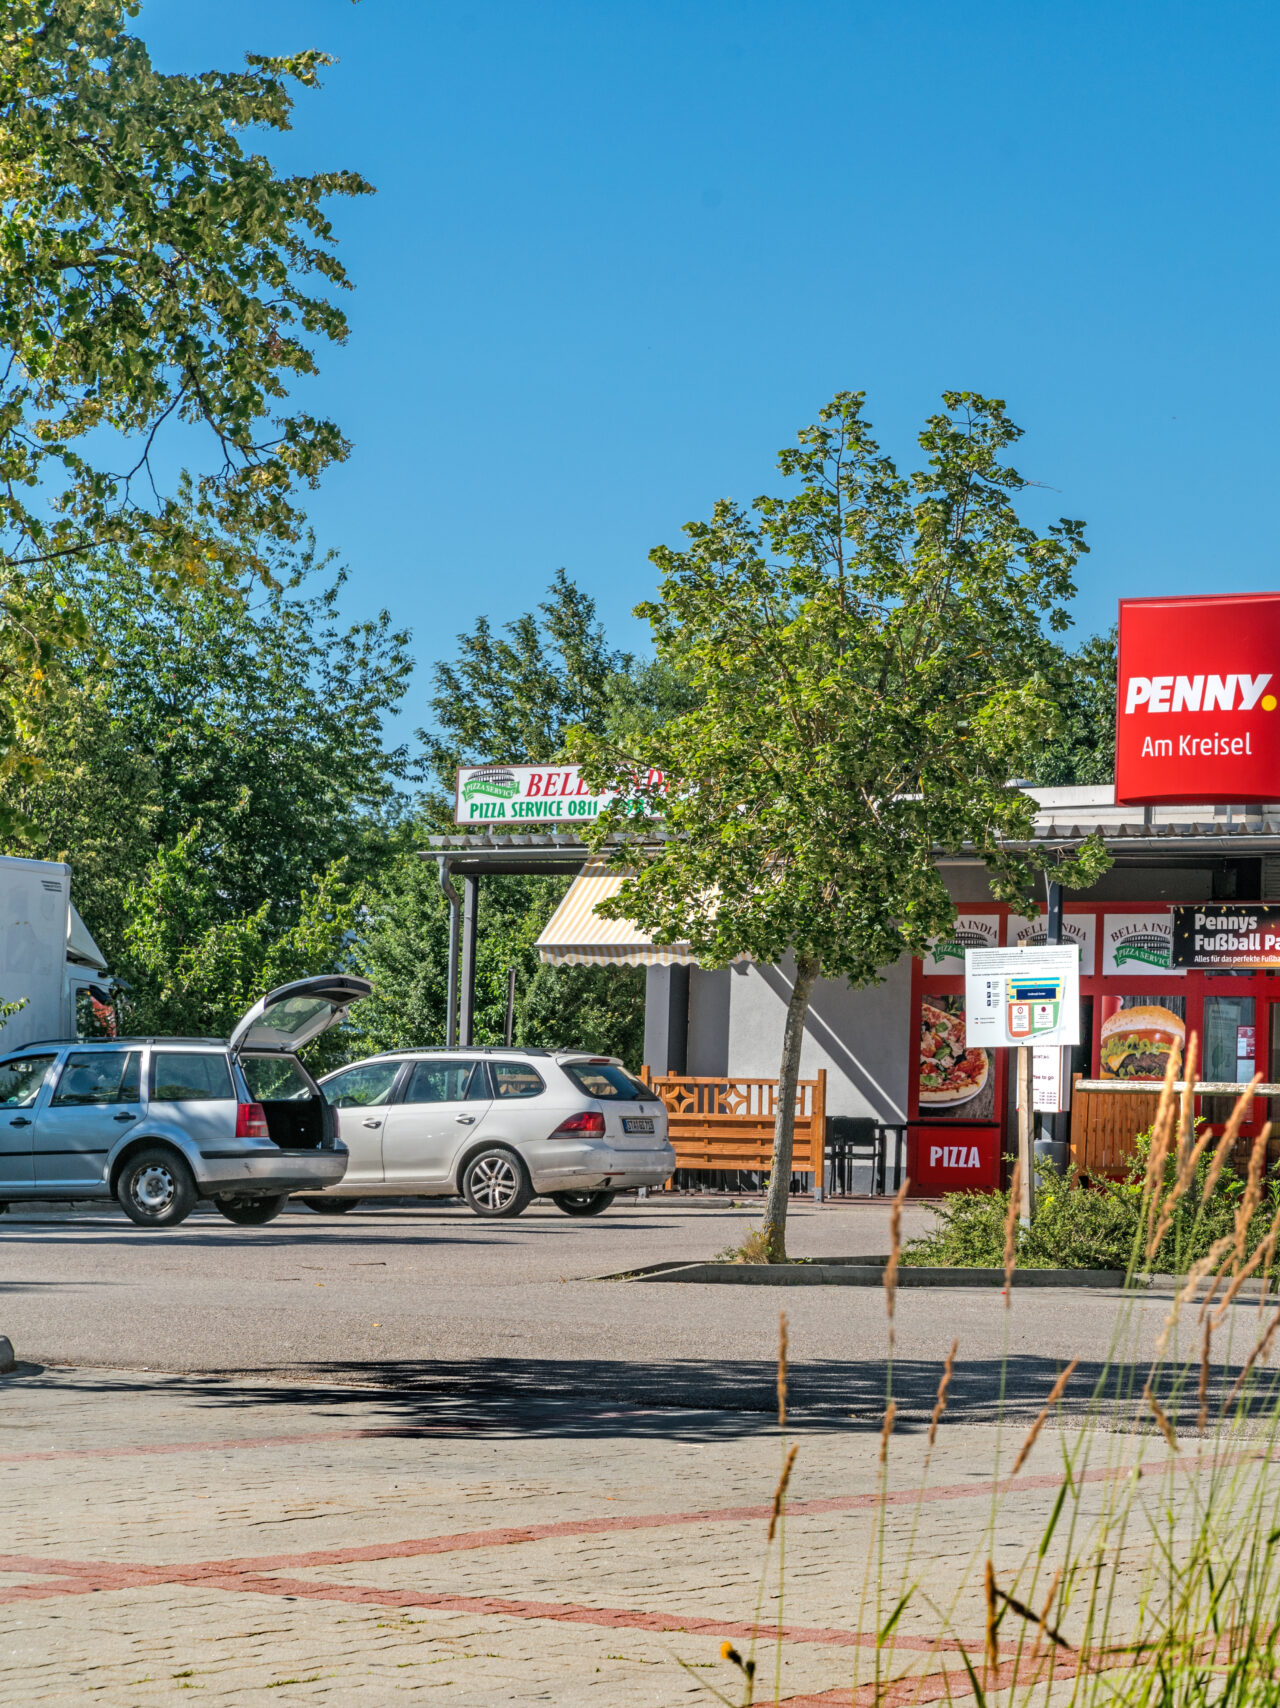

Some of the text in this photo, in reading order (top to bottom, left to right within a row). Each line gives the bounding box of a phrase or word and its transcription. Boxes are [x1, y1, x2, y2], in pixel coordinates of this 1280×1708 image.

[1125, 674, 1277, 714] PENNY.
[1141, 732, 1252, 757] Am Kreisel
[466, 782, 515, 797] PIZZA SERVICE
[469, 802, 506, 819] PIZZA
[510, 799, 563, 818] SERVICE
[567, 799, 598, 816] 0811
[968, 920, 998, 939] INDIA
[1017, 922, 1087, 941] BELL NDIA
[1110, 922, 1171, 942] BELLA IND
[1194, 913, 1258, 934] Pennys
[1194, 933, 1261, 951] Fußball
[1119, 947, 1139, 958] PIZZA
[1194, 955, 1210, 963] Alles
[1211, 954, 1220, 963] für
[1221, 954, 1233, 963] das
[1233, 955, 1261, 964] perfekte
[929, 1145, 981, 1168] PIZZA
